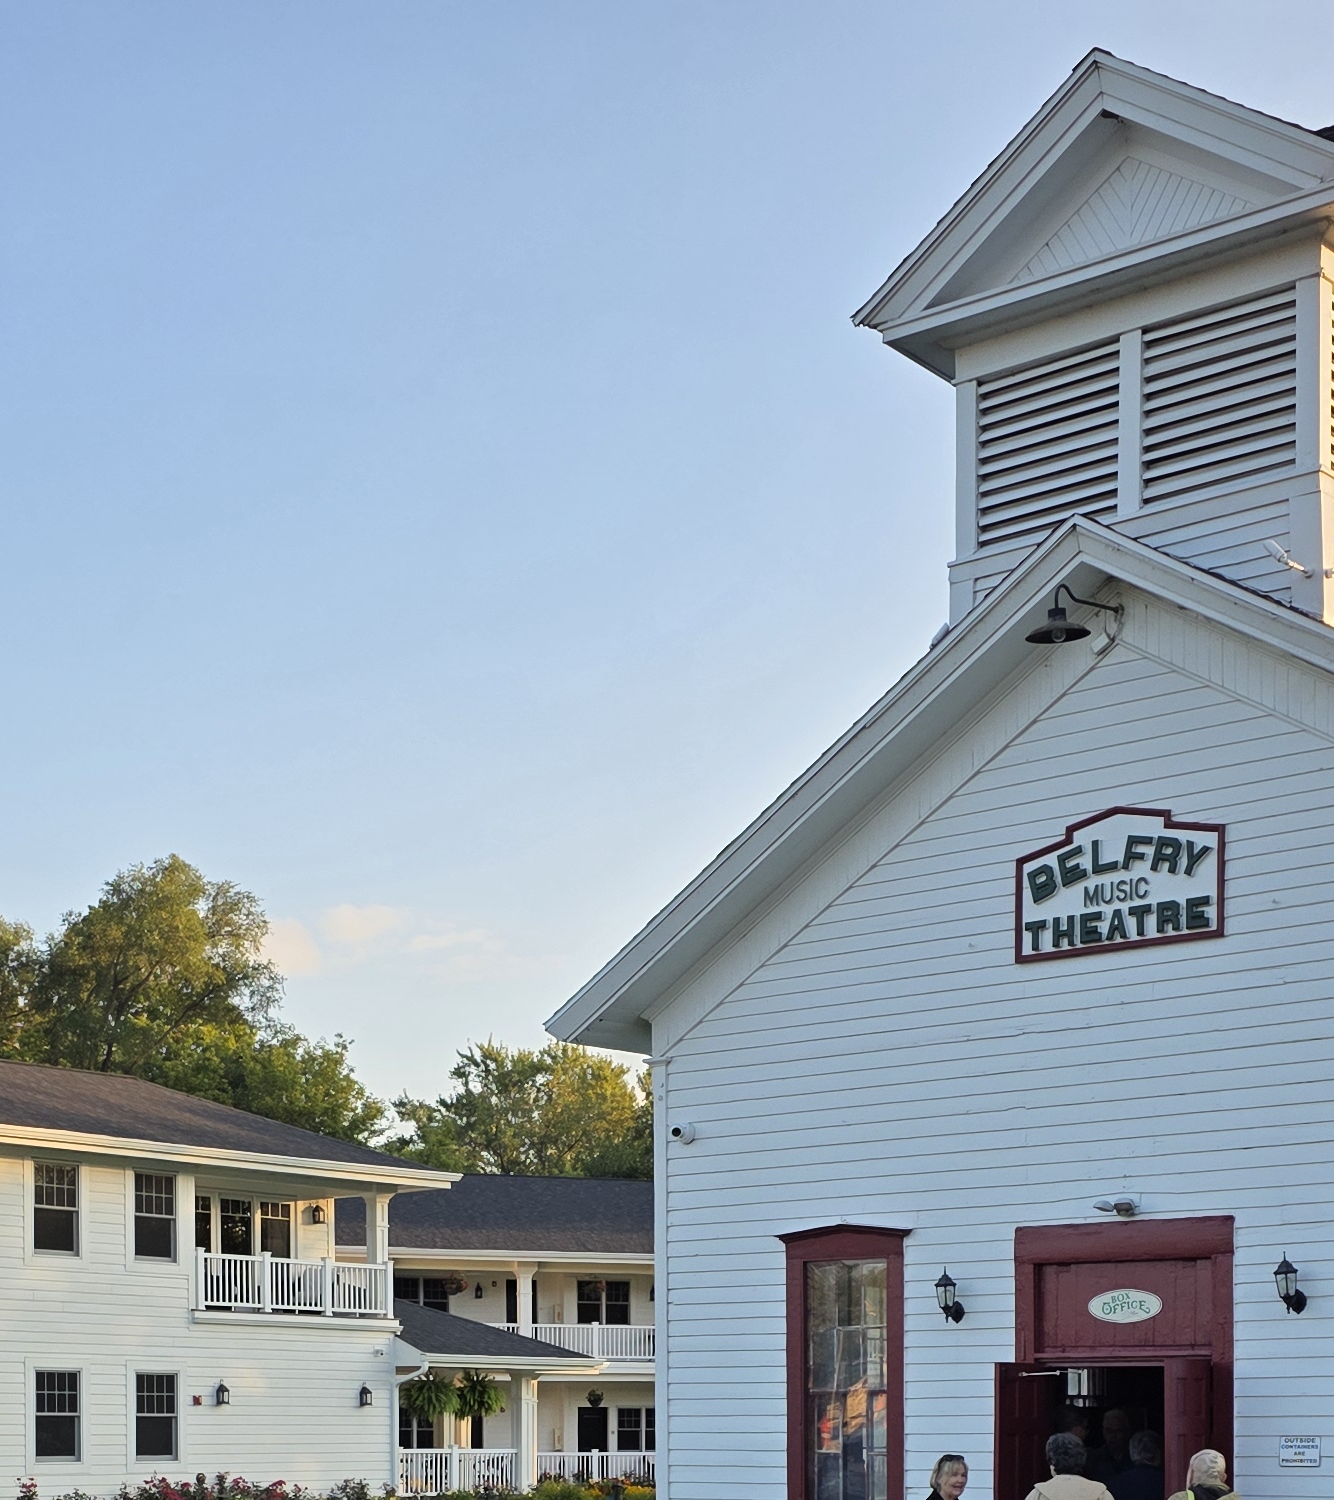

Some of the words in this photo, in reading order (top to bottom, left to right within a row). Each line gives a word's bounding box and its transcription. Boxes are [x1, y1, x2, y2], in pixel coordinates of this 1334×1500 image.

[1027, 835, 1212, 904] BELFRY
[1084, 877, 1149, 908] MUSIC
[1025, 895, 1212, 951] THEATRE
[1102, 1300, 1150, 1315] OFFICE
[1111, 1292, 1131, 1304] BOX
